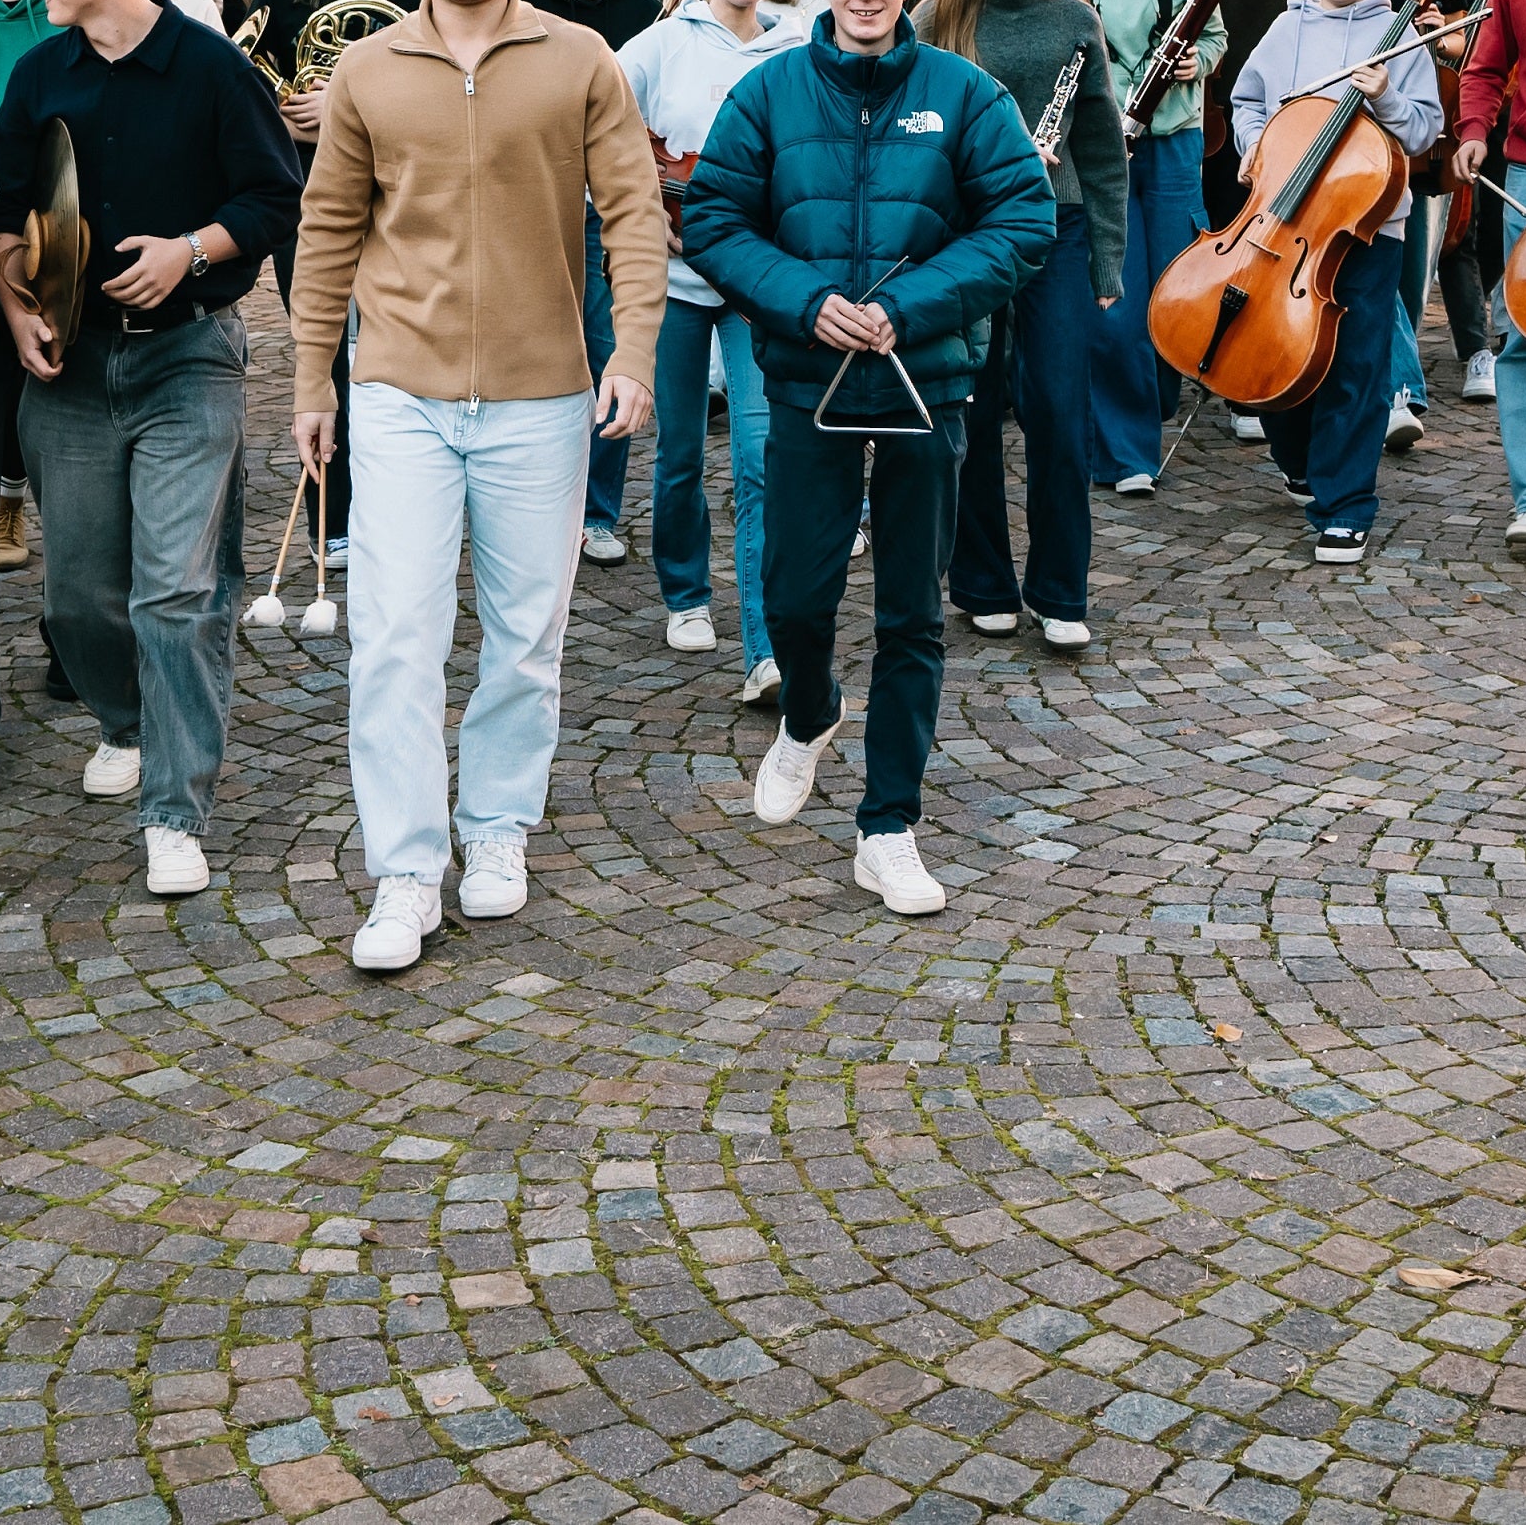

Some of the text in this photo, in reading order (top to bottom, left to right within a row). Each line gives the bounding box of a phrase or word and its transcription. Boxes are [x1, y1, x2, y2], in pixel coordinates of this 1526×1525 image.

[911, 111, 927, 121] THE
[897, 119, 927, 127] NORTH
[906, 126, 927, 134] FACE
